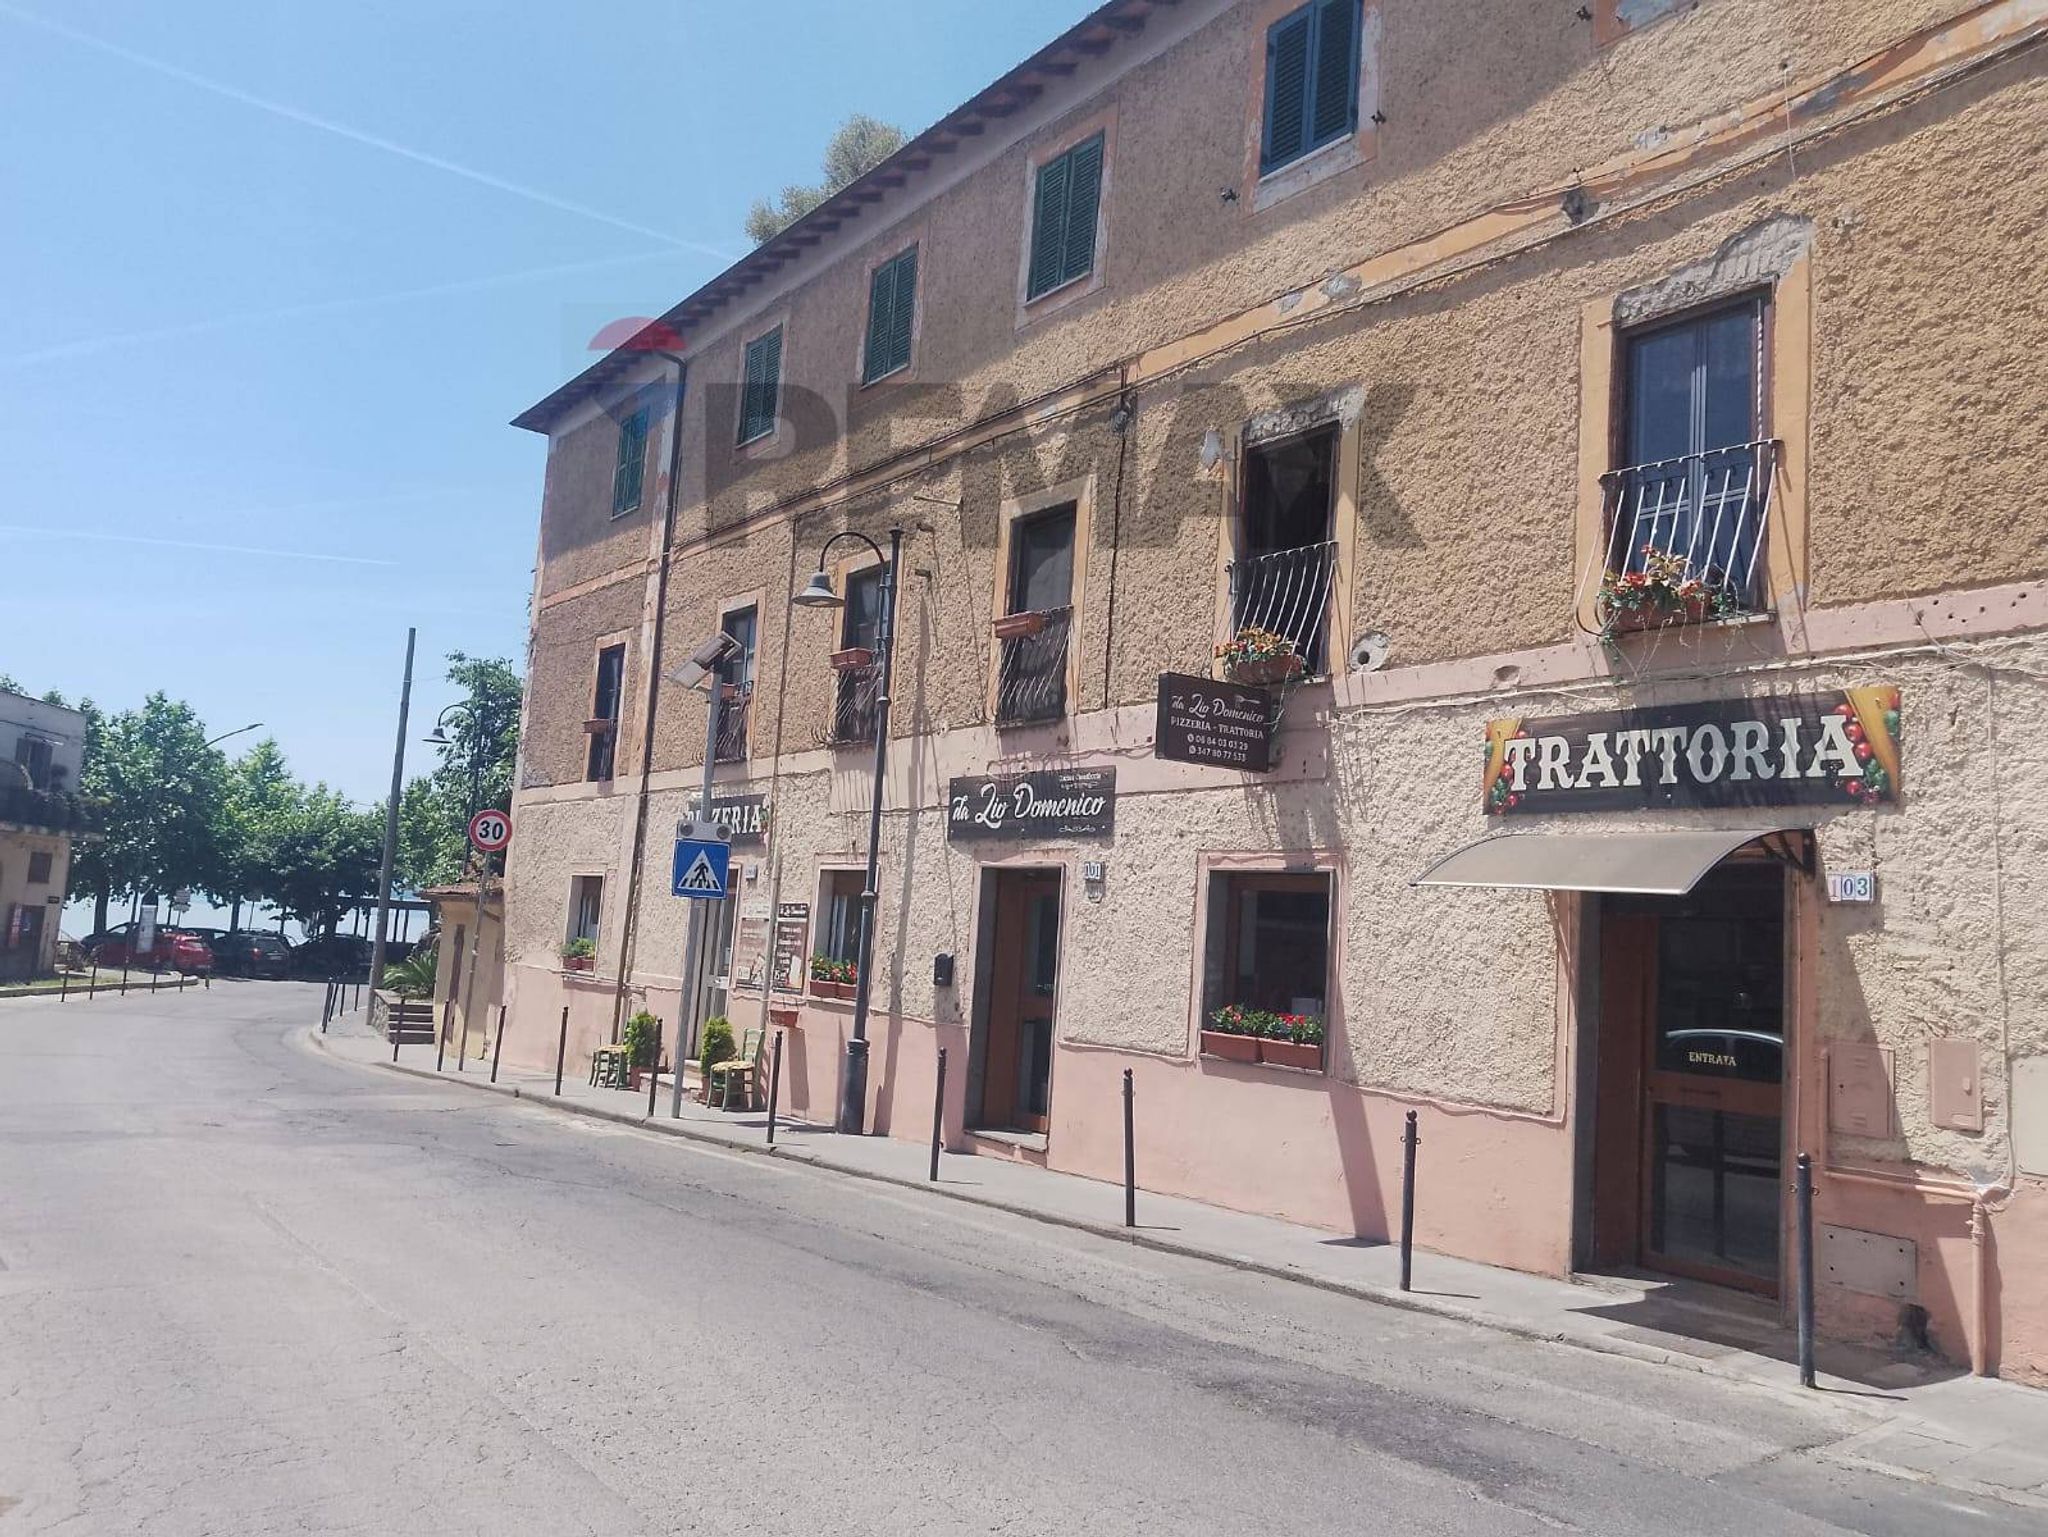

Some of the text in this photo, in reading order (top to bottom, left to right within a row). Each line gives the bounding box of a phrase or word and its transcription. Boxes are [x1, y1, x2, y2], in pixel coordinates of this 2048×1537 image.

[1212, 698, 1264, 722] Domenico
[1170, 716, 1211, 731] PIZZERIA
[1217, 723, 1264, 739] TRATTORIA
[1503, 714, 1864, 792] TRATTORIA
[975, 782, 1009, 829] Zio
[1013, 782, 1107, 819] Domenico
[478, 820, 504, 840] 30
[1831, 878, 1868, 897] 103
[1688, 1051, 1737, 1067] ENTRATA
